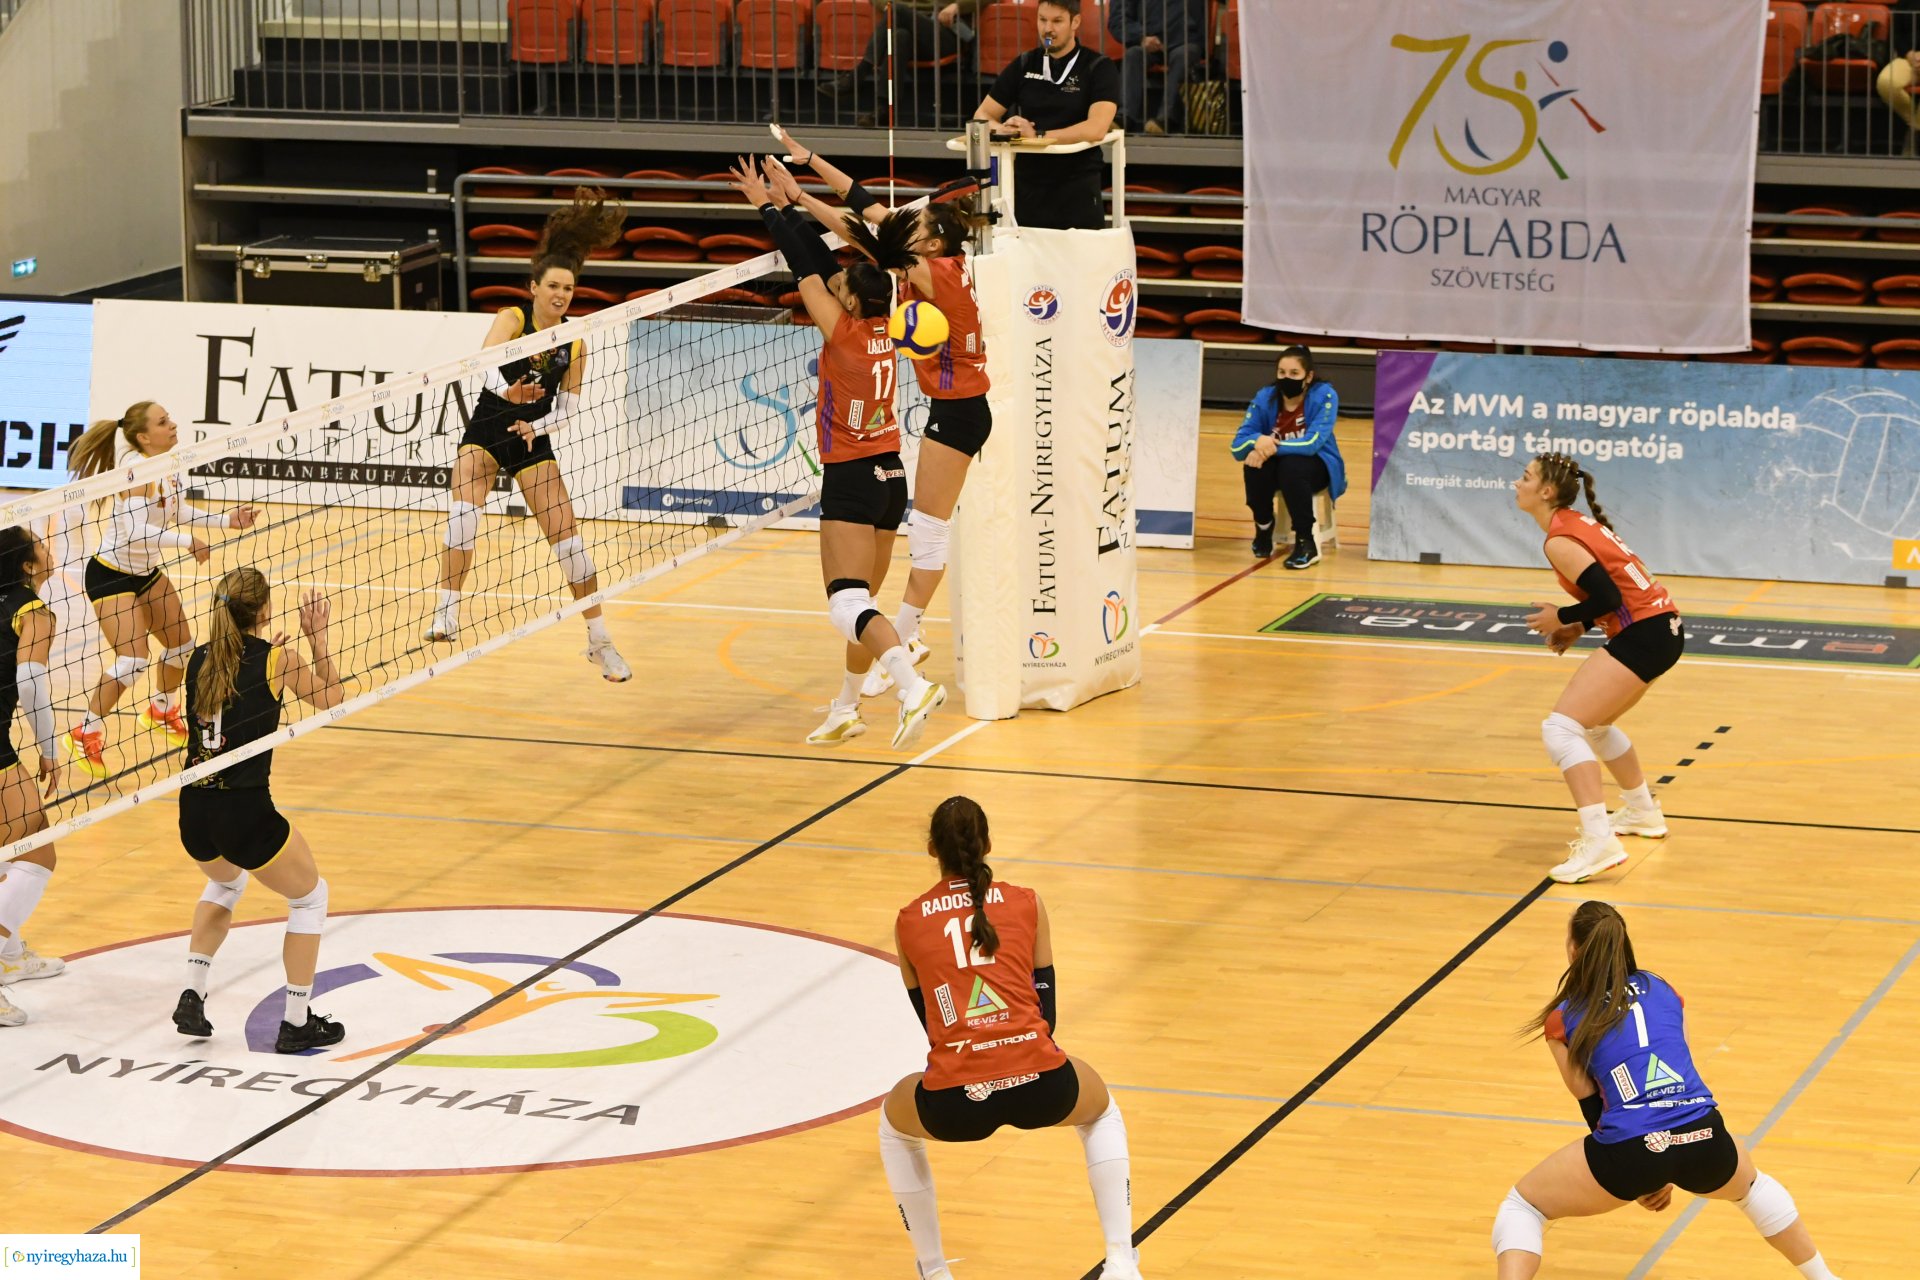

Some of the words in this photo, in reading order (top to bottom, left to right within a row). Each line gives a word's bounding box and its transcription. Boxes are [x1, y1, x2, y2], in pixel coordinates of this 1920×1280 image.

[1388, 34, 1546, 175] 75
[1444, 186, 1542, 207] MAGYAR
[1362, 204, 1627, 263] RÖPLABDA
[1033, 285, 1055, 293] FATUM
[1431, 266, 1555, 292] SZÖVETSÉG
[872, 358, 894, 400] 17
[851, 401, 861, 428] STRABAG
[1409, 391, 1444, 415] Az
[1453, 393, 1524, 418] MVM
[1532, 401, 1548, 420] a
[1557, 404, 1661, 428] magyar
[1669, 402, 1797, 431] röplabda
[0, 420, 84, 470] CH
[1408, 427, 1515, 456] sportág
[1525, 429, 1683, 464] támogatója
[1031, 337, 1057, 616] FATUM-NYÍREGYHÁZA
[1097, 370, 1127, 563] FATUM
[1406, 473, 1462, 490] Energiát
[1466, 474, 1505, 489] adunk
[63, 487, 85, 503] FATUM
[1345, 605, 1486, 621] Online
[1095, 642, 1134, 667] NYÍREGYHÁZA
[922, 887, 1004, 917] RADOSVA
[944, 914, 996, 969] 12
[940, 987, 952, 1024] STRABAG
[967, 1014, 998, 1027] KE-VIZ
[1000, 1012, 1009, 1021] 21
[1620, 1001, 1649, 1048] 1
[972, 1031, 1038, 1052] BESTRONG
[35, 1053, 641, 1125] NYÍREGYHÁZA
[1616, 1067, 1634, 1099] STRABAG
[1646, 1086, 1676, 1099] KE-VIZ
[1676, 1085, 1687, 1094] 21
[1671, 1128, 1713, 1146] REVESZ
